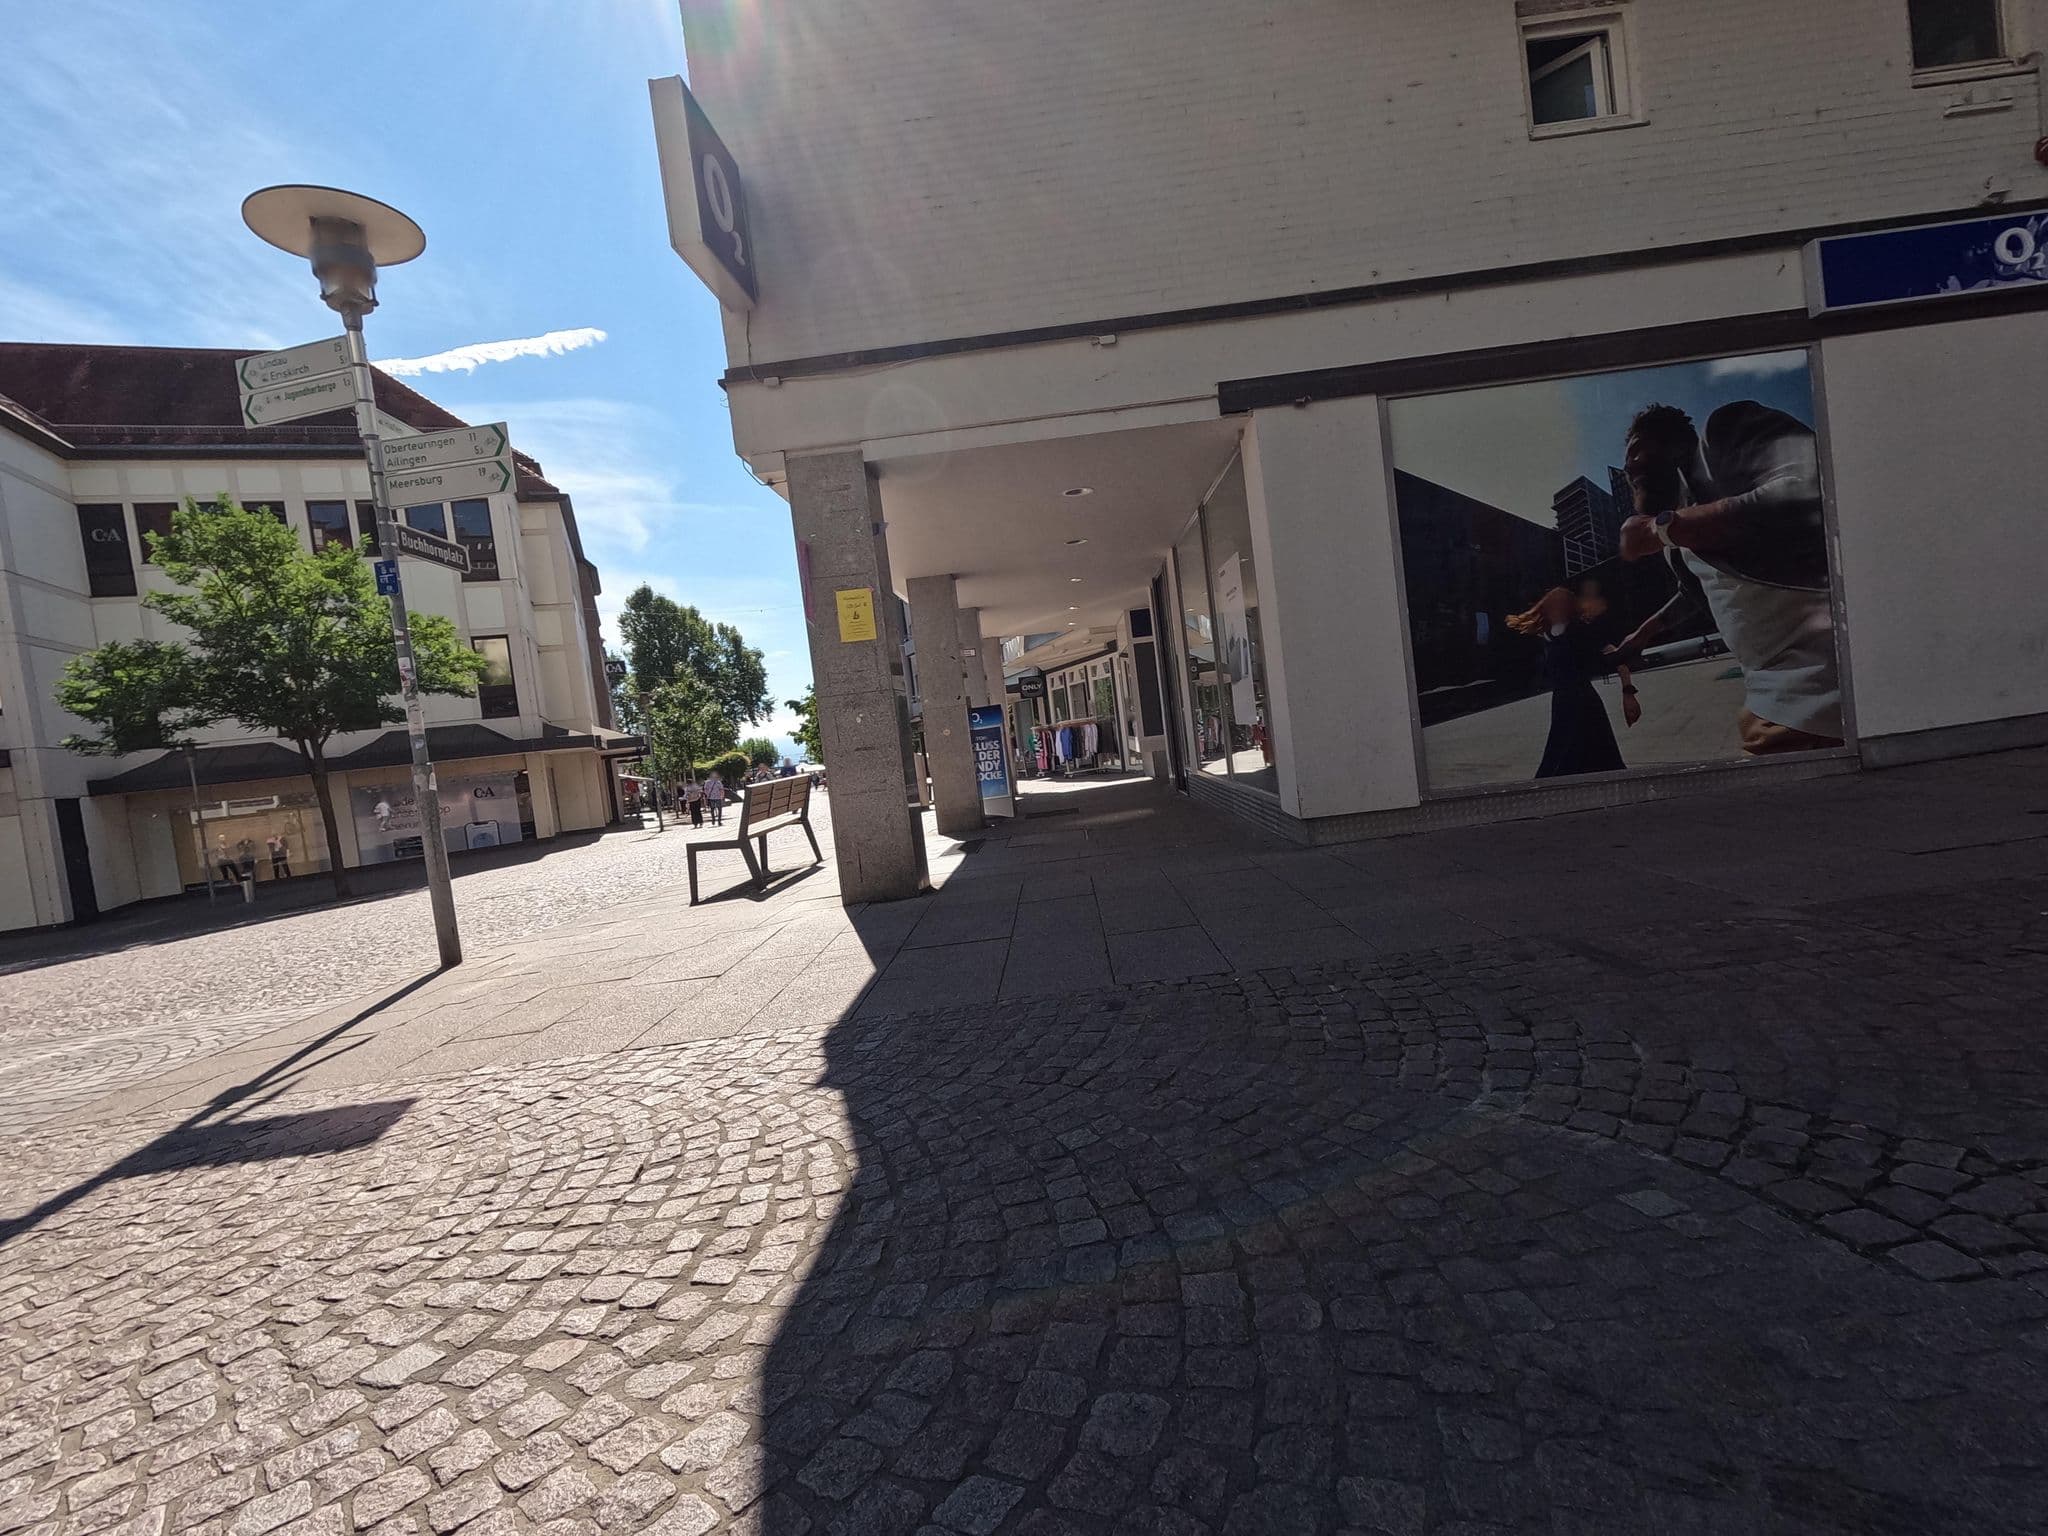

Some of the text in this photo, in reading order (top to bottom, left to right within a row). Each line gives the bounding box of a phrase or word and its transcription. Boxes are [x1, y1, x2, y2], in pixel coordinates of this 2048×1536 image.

[258, 356, 288, 370] Lindau
[284, 382, 336, 401] Jugendherberge
[383, 432, 477, 454] Oberteuringen 11
[387, 455, 427, 468] Ailingen
[389, 475, 442, 489] Meersburg
[401, 531, 465, 565] Buchhornplatz
[1021, 682, 1042, 692] ONLY
[975, 740, 1000, 752] LUSS
[979, 750, 1000, 761] DER
[978, 760, 1001, 772] NDY
[978, 770, 1004, 781] OCKE
